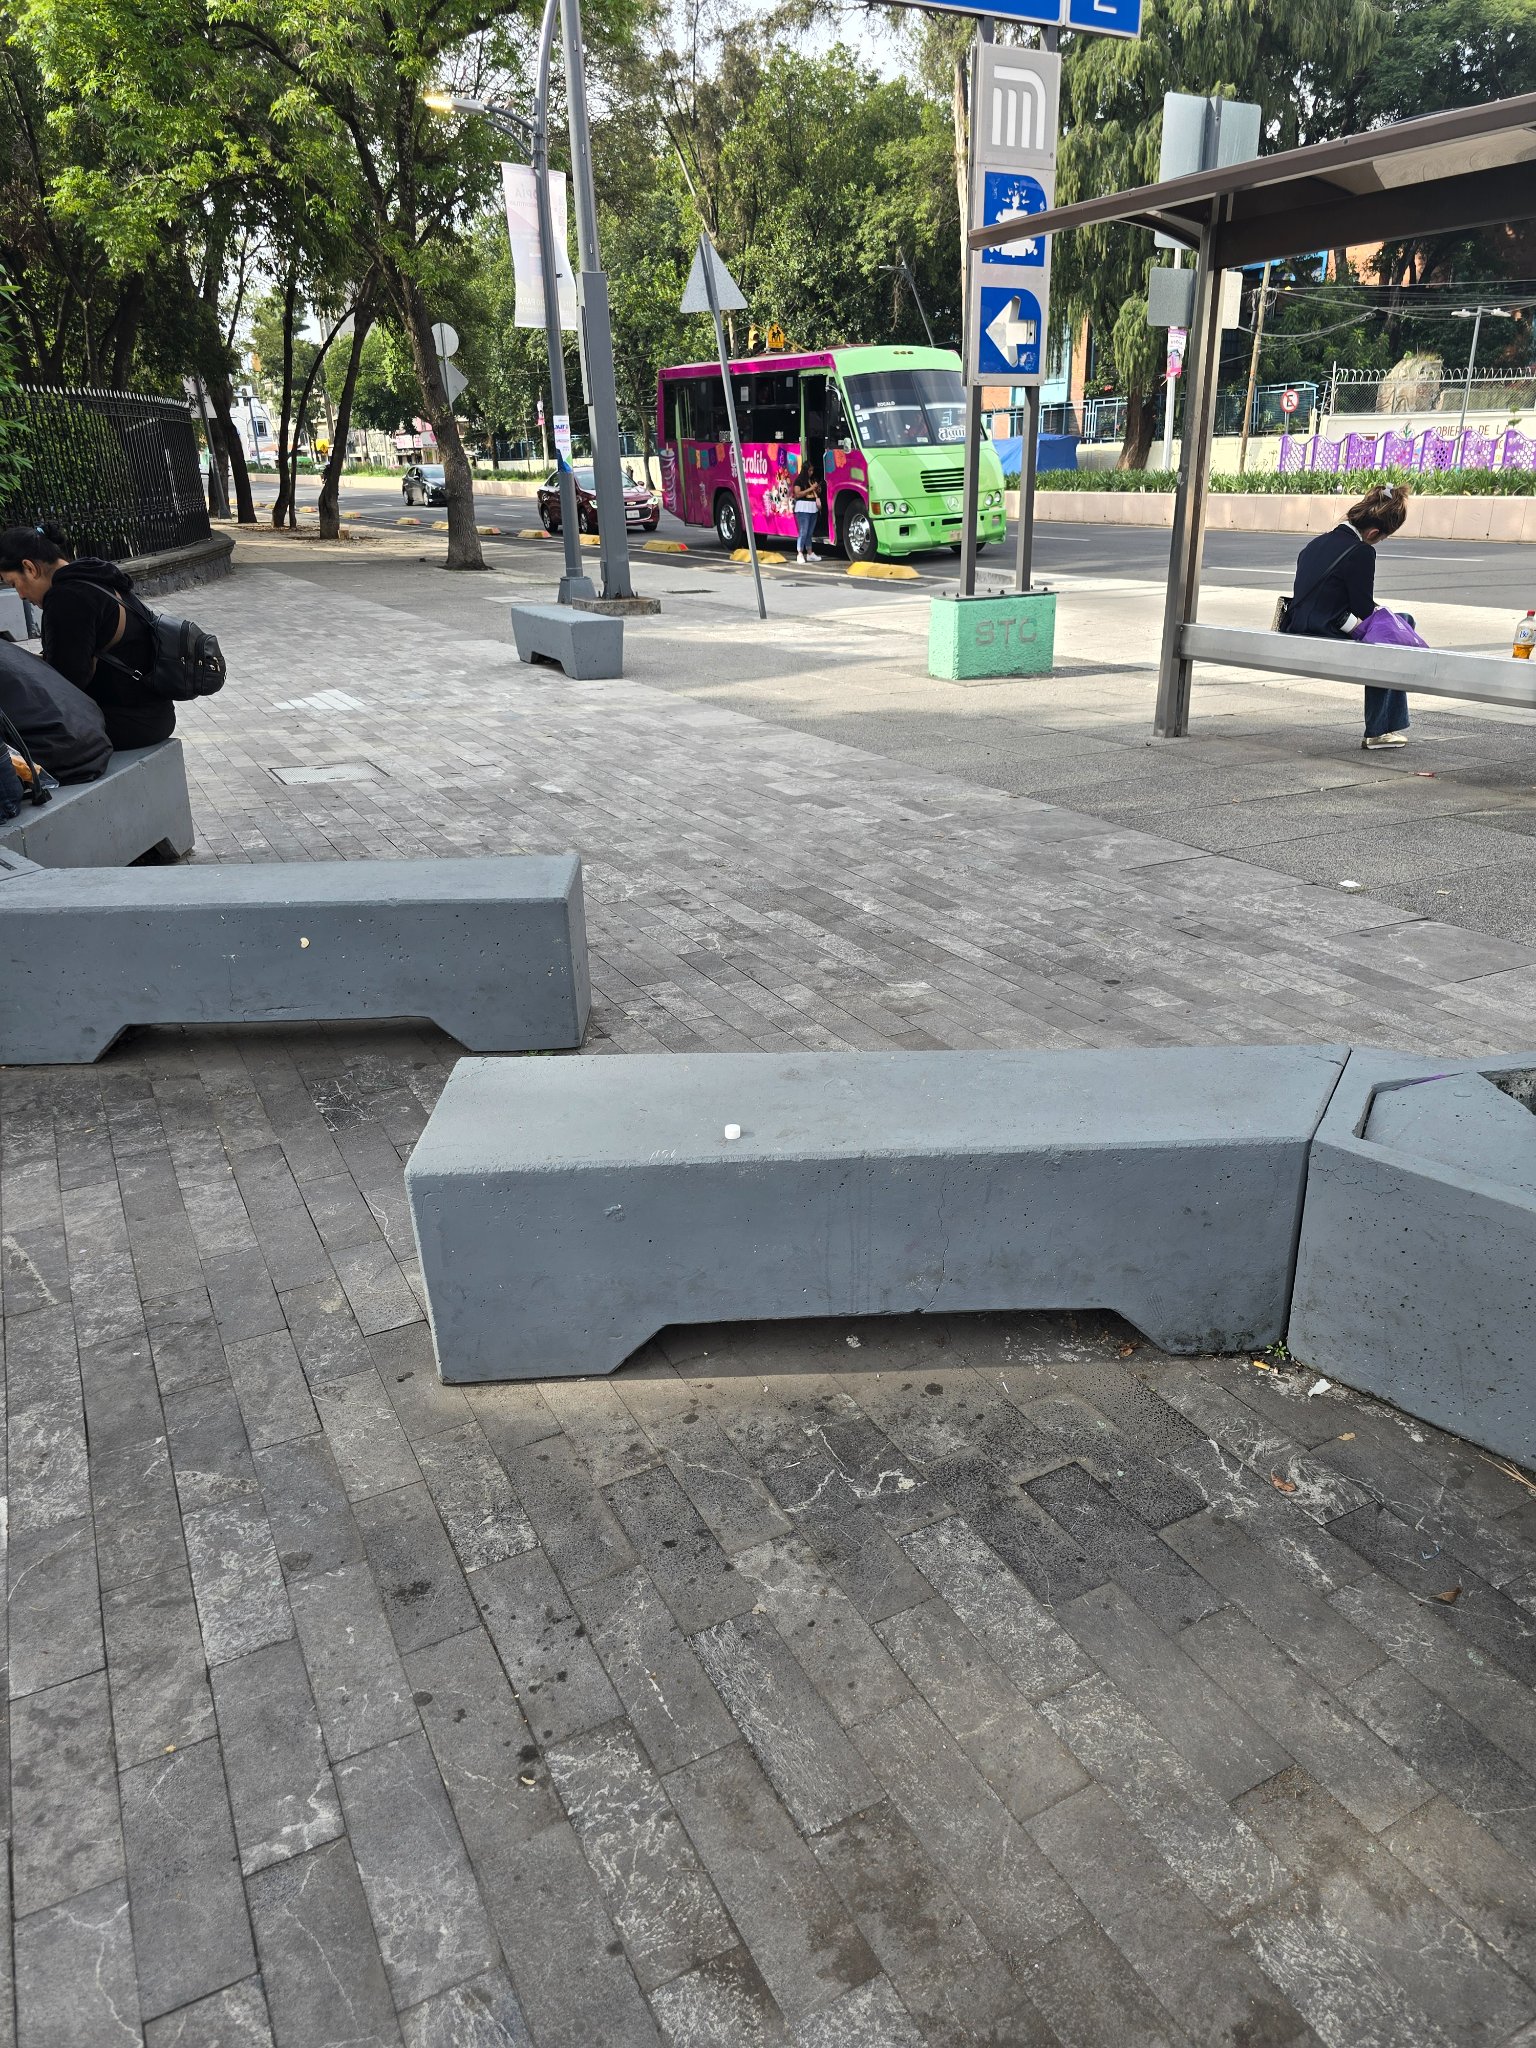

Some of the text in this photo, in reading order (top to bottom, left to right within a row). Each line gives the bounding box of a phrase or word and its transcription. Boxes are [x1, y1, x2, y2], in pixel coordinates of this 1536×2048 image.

[1478, 424, 1490, 436] DE
[739, 450, 768, 475] arolito
[975, 617, 1037, 647] STC
